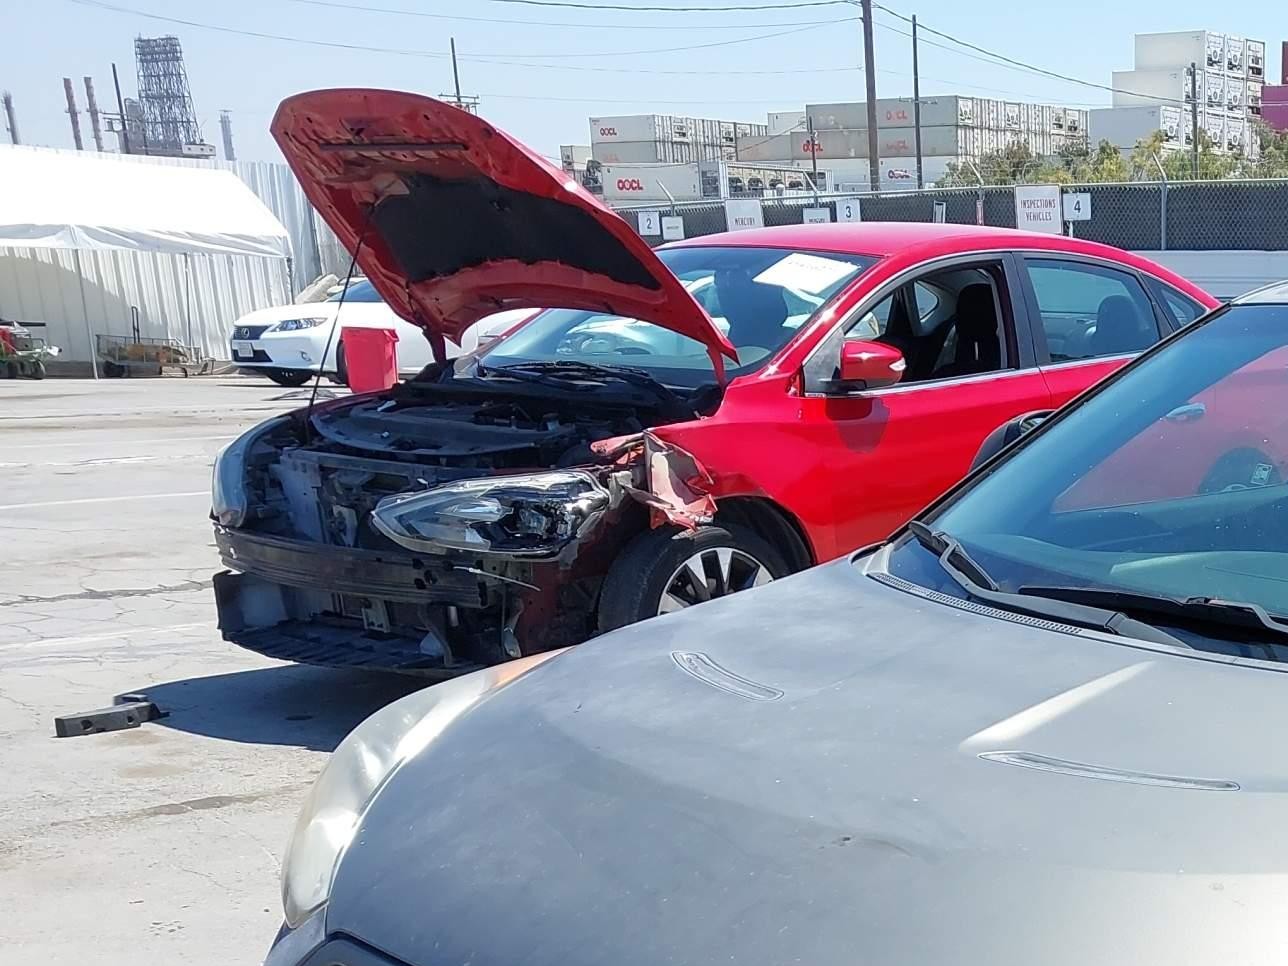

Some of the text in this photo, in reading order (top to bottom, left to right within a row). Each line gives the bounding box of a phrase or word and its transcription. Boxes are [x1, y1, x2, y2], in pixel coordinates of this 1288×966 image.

[600, 127, 617, 136] OOCL
[617, 179, 643, 191] OOCL
[1020, 199, 1056, 209] INSPECTIONS
[1073, 200, 1081, 213] 4
[845, 206, 852, 218] 3
[1025, 211, 1052, 221] VEHICLES
[646, 218, 652, 229] 2
